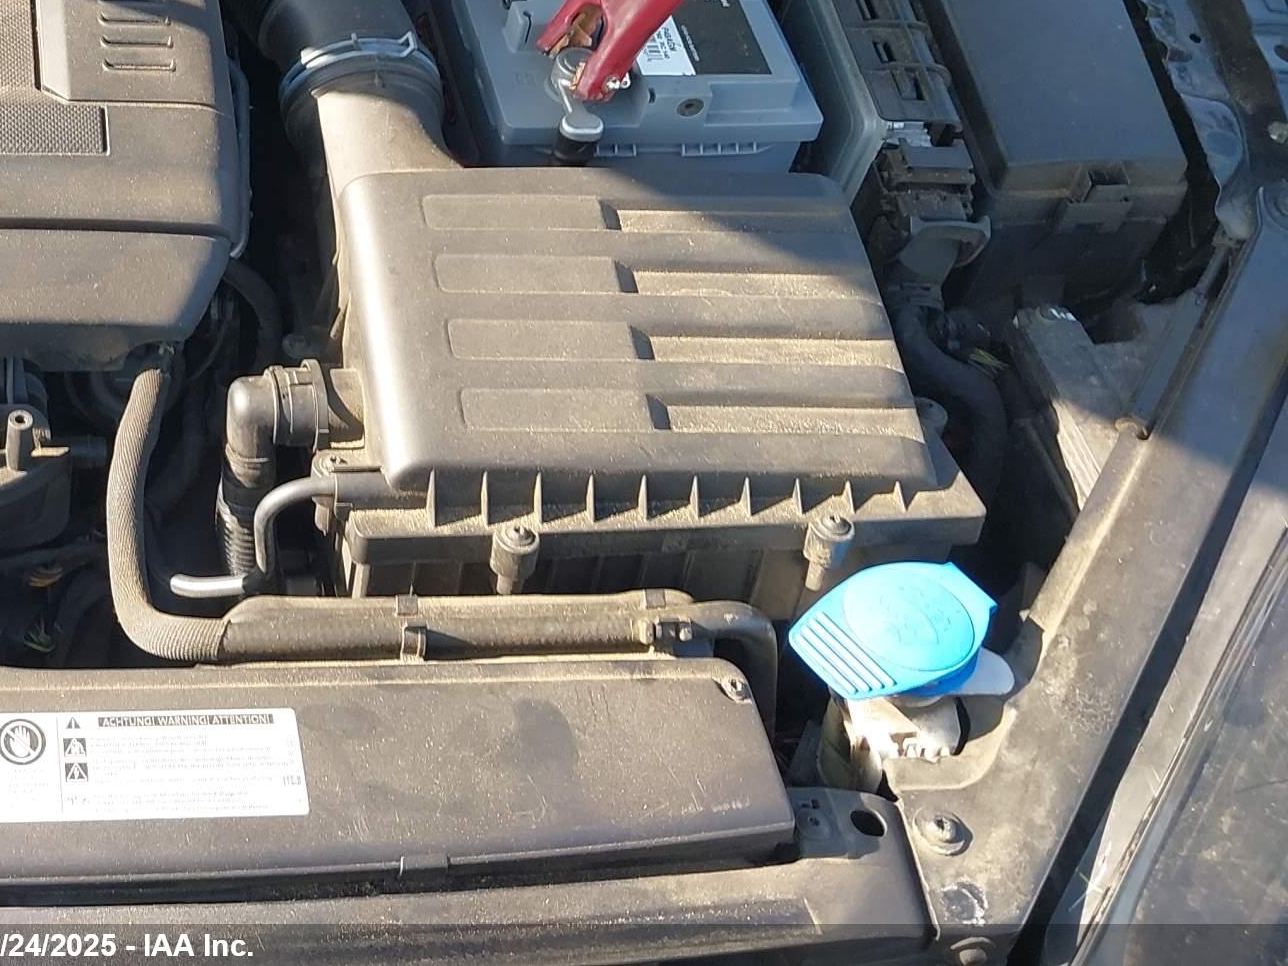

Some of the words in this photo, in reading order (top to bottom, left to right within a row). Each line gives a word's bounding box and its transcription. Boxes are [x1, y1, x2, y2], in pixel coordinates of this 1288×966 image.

[102, 716, 156, 727] ACHTUNG!
[157, 715, 209, 726] WARNING!
[212, 714, 271, 725] ATTENTION!
